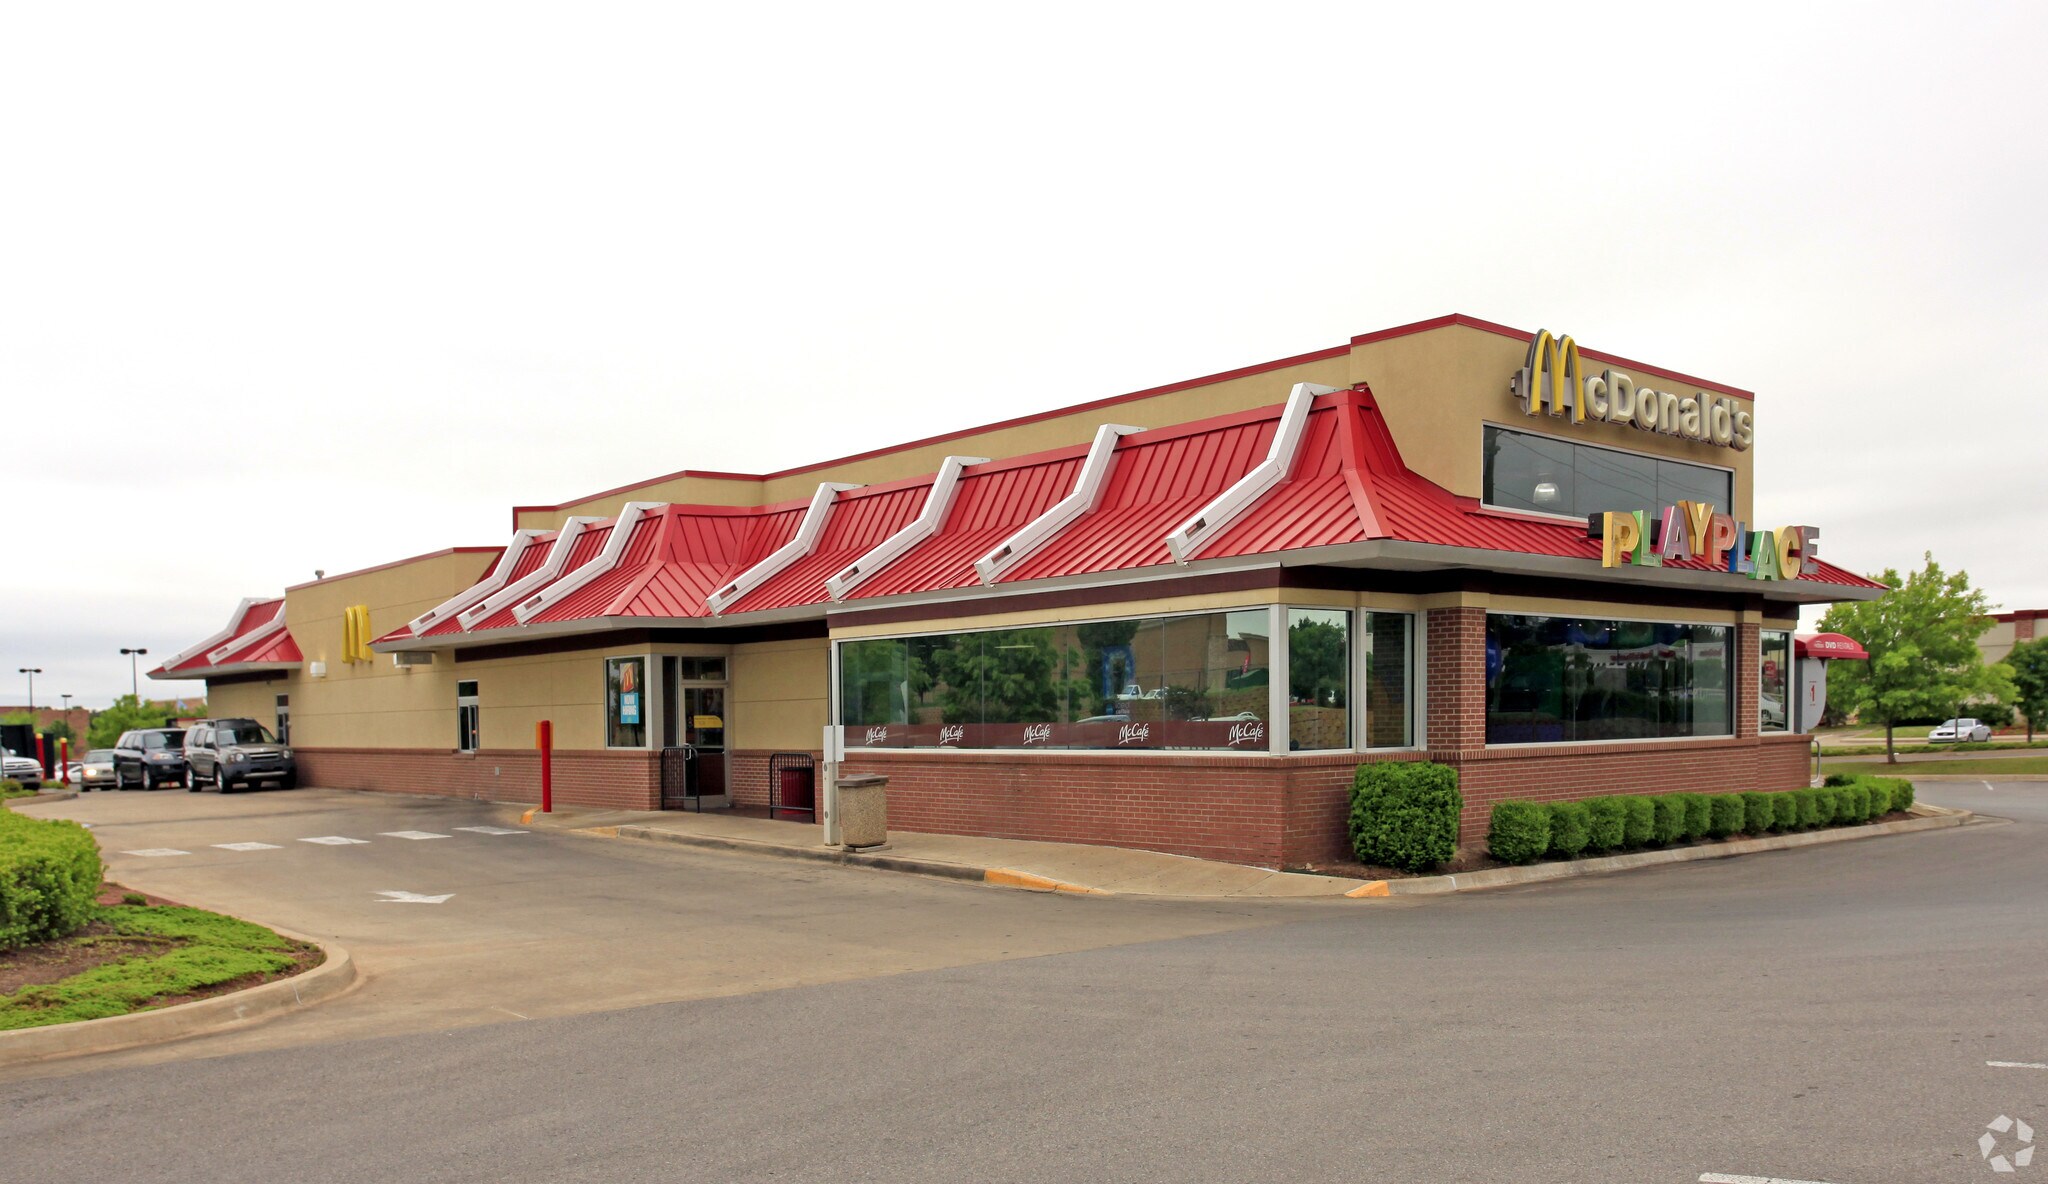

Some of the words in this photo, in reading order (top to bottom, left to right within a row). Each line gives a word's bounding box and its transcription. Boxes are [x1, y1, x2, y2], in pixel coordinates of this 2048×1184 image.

[1521, 328, 1752, 452] McDonald's
[1602, 500, 1820, 581] PLAYPLACE
[1825, 641, 1836, 649] DVD
